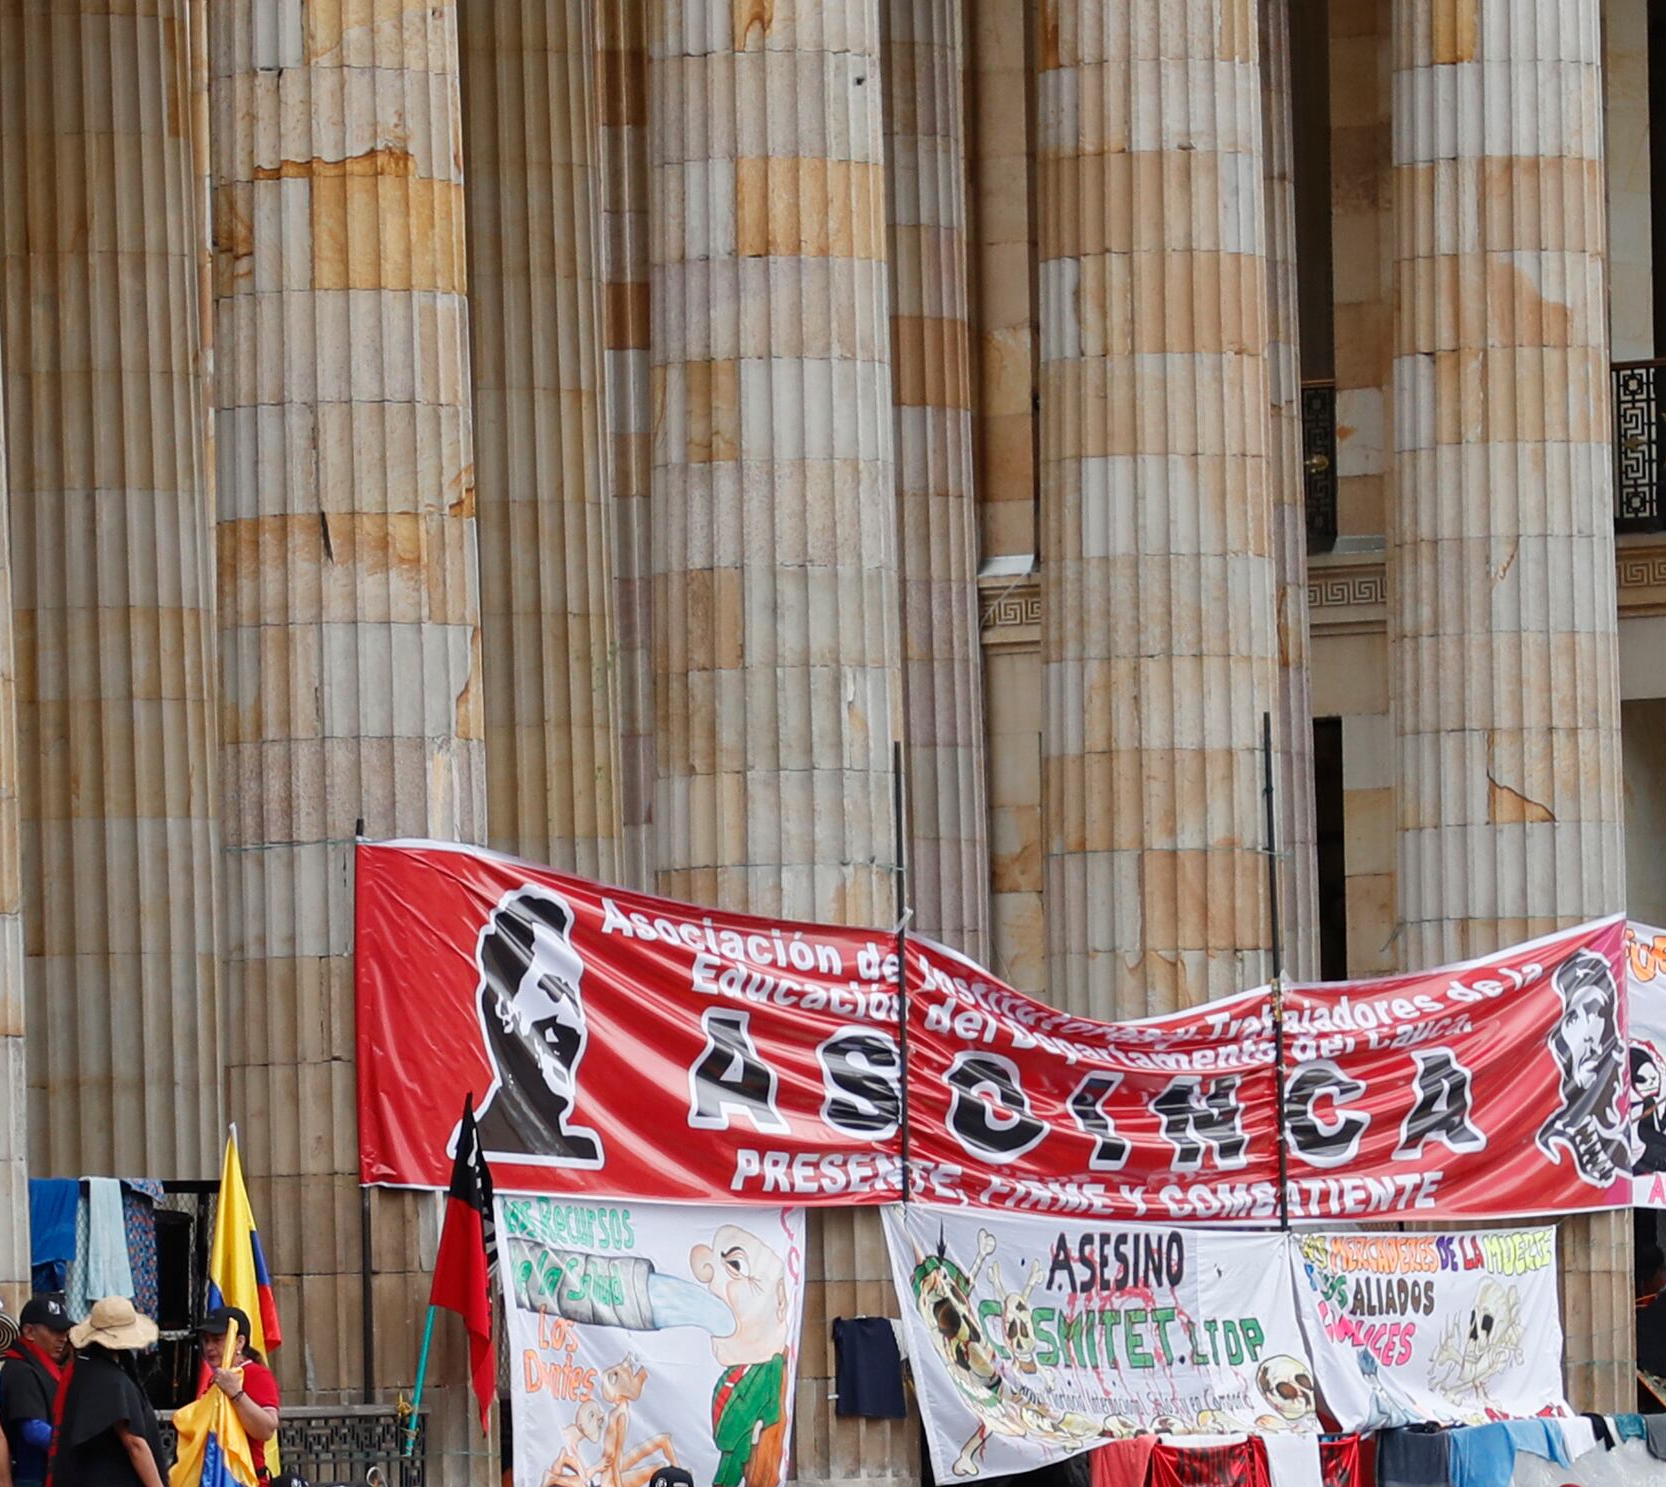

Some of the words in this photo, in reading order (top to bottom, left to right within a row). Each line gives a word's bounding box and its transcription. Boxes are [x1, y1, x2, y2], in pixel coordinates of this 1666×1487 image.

[601, 897, 843, 975] Asociación
[856, 941, 899, 983] de
[1205, 990, 1445, 1041] Trabajadores
[1446, 976, 1504, 1003] de
[1504, 962, 1543, 990] la
[690, 952, 910, 1022] Educación
[924, 996, 997, 1044] del
[1119, 1184, 1146, 1217] Y
[1159, 1171, 1444, 1218] COMBATIENTE
[537, 1197, 634, 1250] Recursos
[1045, 1231, 1186, 1294] ASESINO
[1436, 1235, 1459, 1272] DE
[1460, 1235, 1484, 1271] LA
[1350, 1276, 1435, 1317] ALIADOS
[537, 1304, 580, 1353] Los
